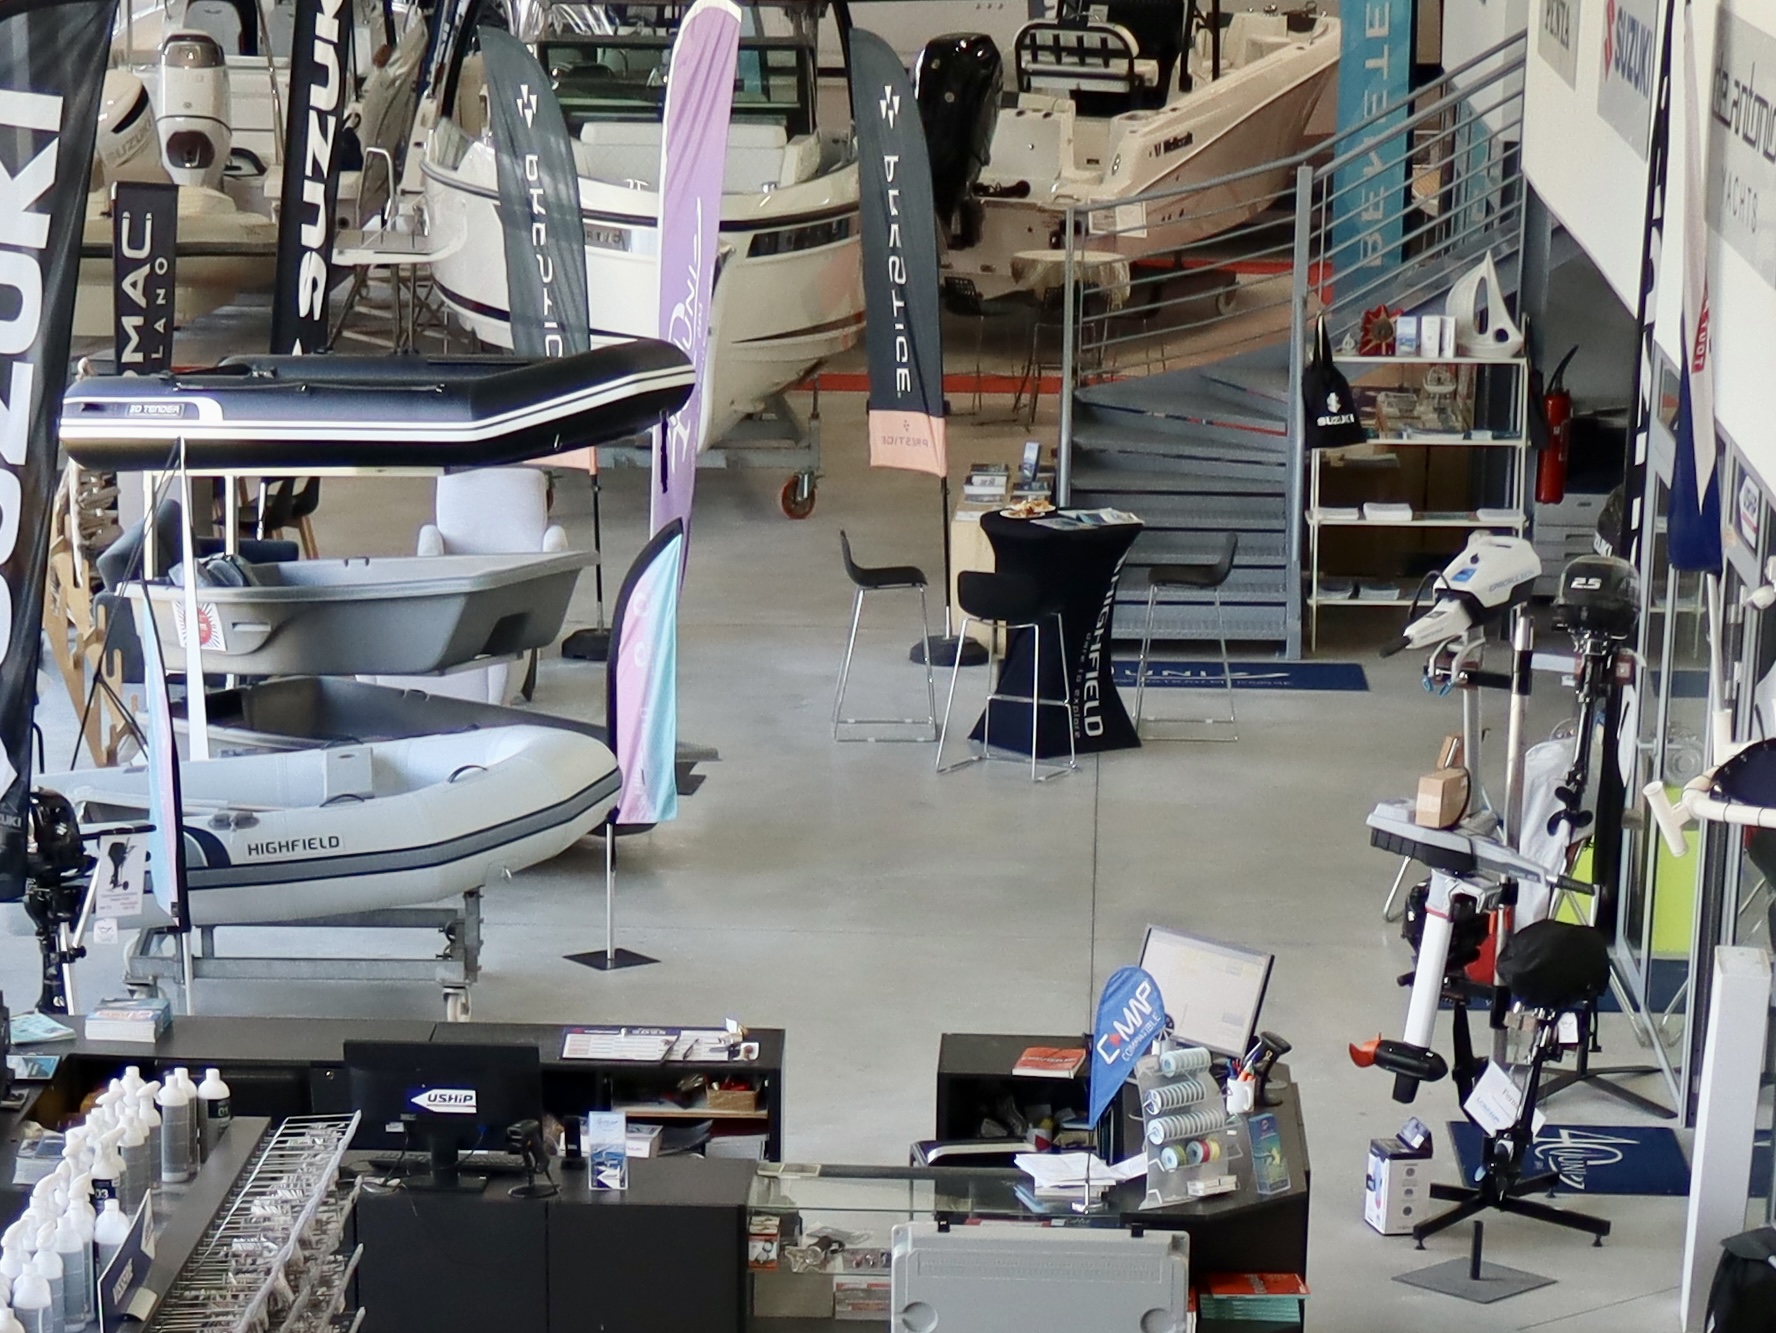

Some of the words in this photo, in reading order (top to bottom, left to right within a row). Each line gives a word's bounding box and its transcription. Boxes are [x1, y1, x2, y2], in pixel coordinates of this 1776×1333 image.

[1614, 5, 1654, 99] SUZUKI
[122, 211, 154, 376] MAC
[247, 835, 341, 855] HIGHFIELD
[1121, 1012, 1162, 1063] COMPATIBLE
